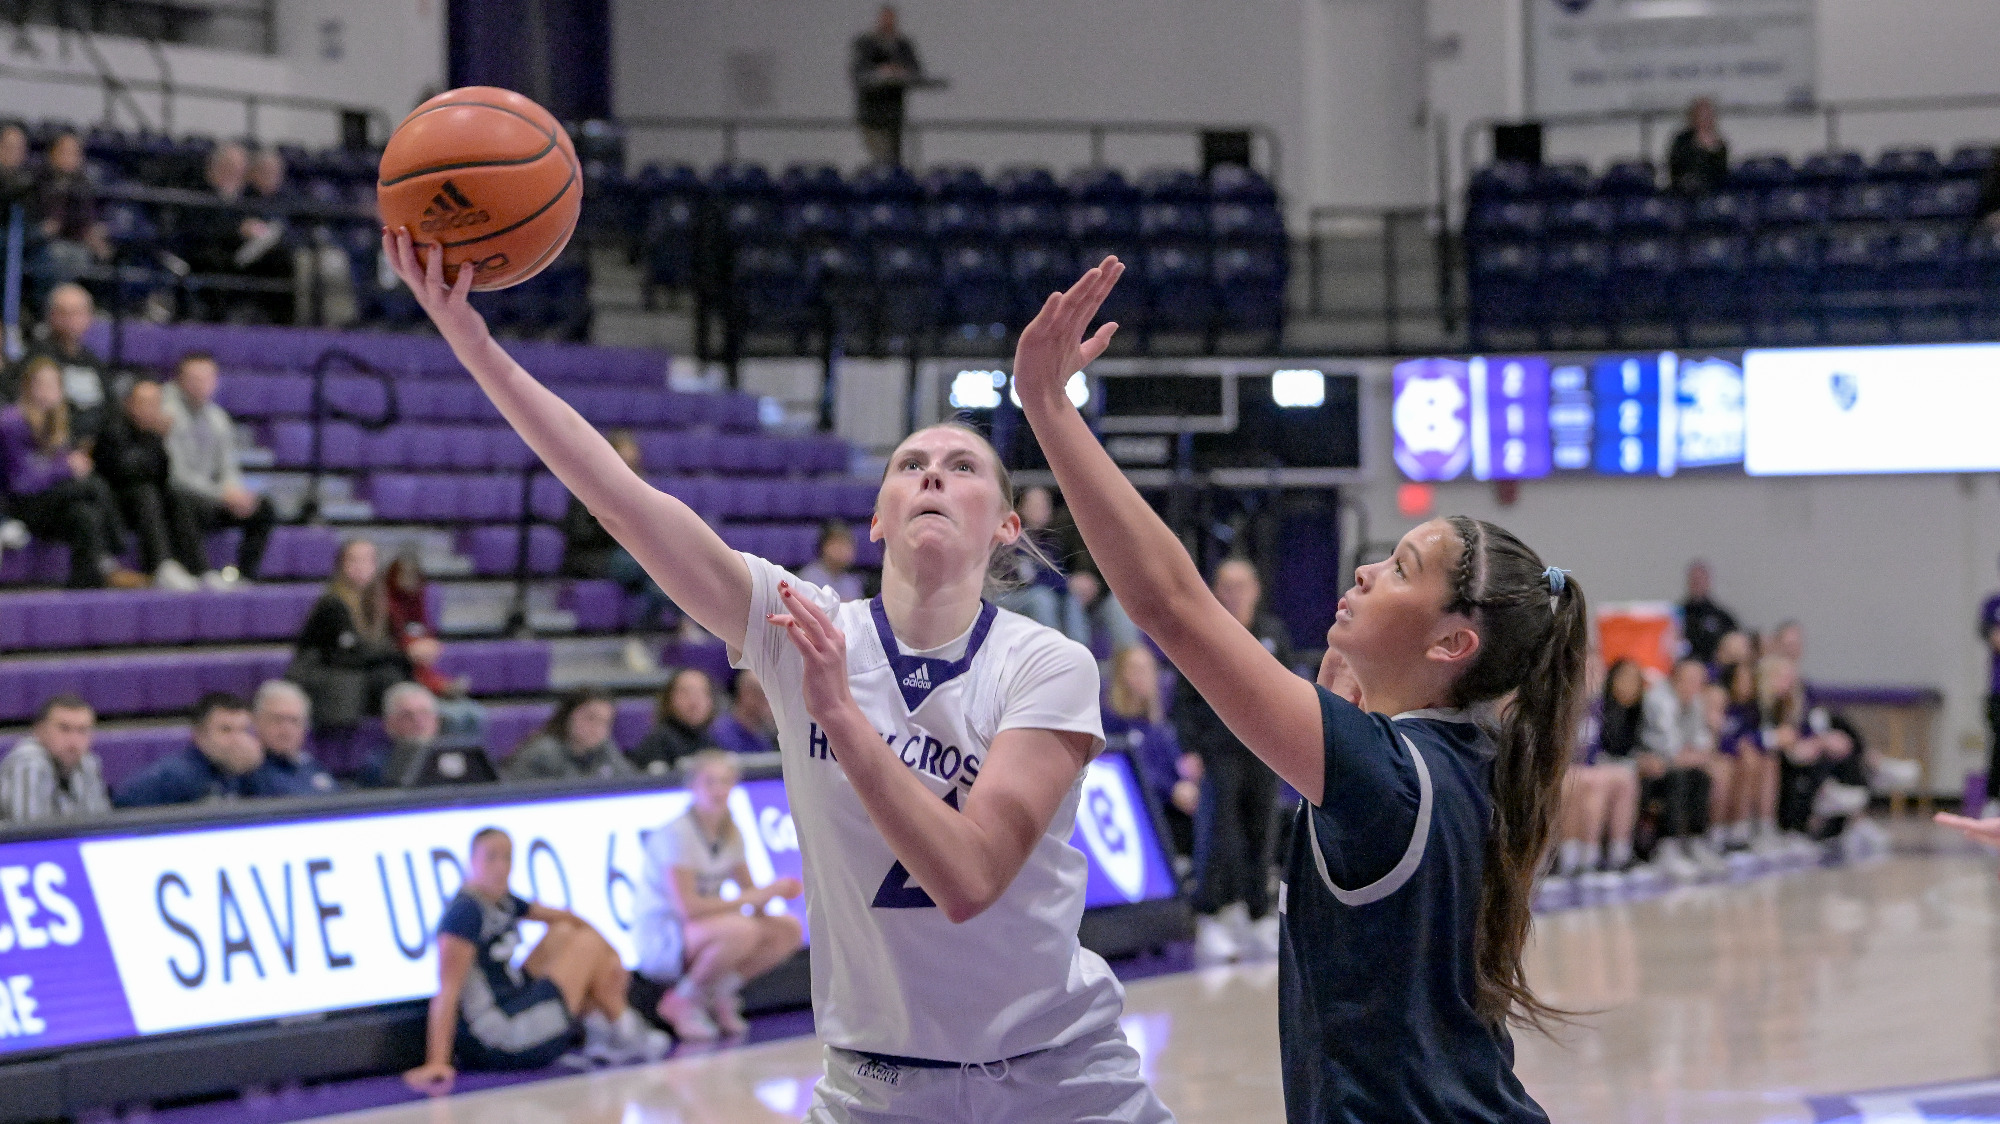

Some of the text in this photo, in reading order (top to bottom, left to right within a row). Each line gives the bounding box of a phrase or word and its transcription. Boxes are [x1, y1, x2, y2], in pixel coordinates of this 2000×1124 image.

[902, 675, 932, 690] adidas
[900, 735, 980, 787] CROS
[155, 857, 355, 989] SAVE
[375, 847, 467, 960] UP
